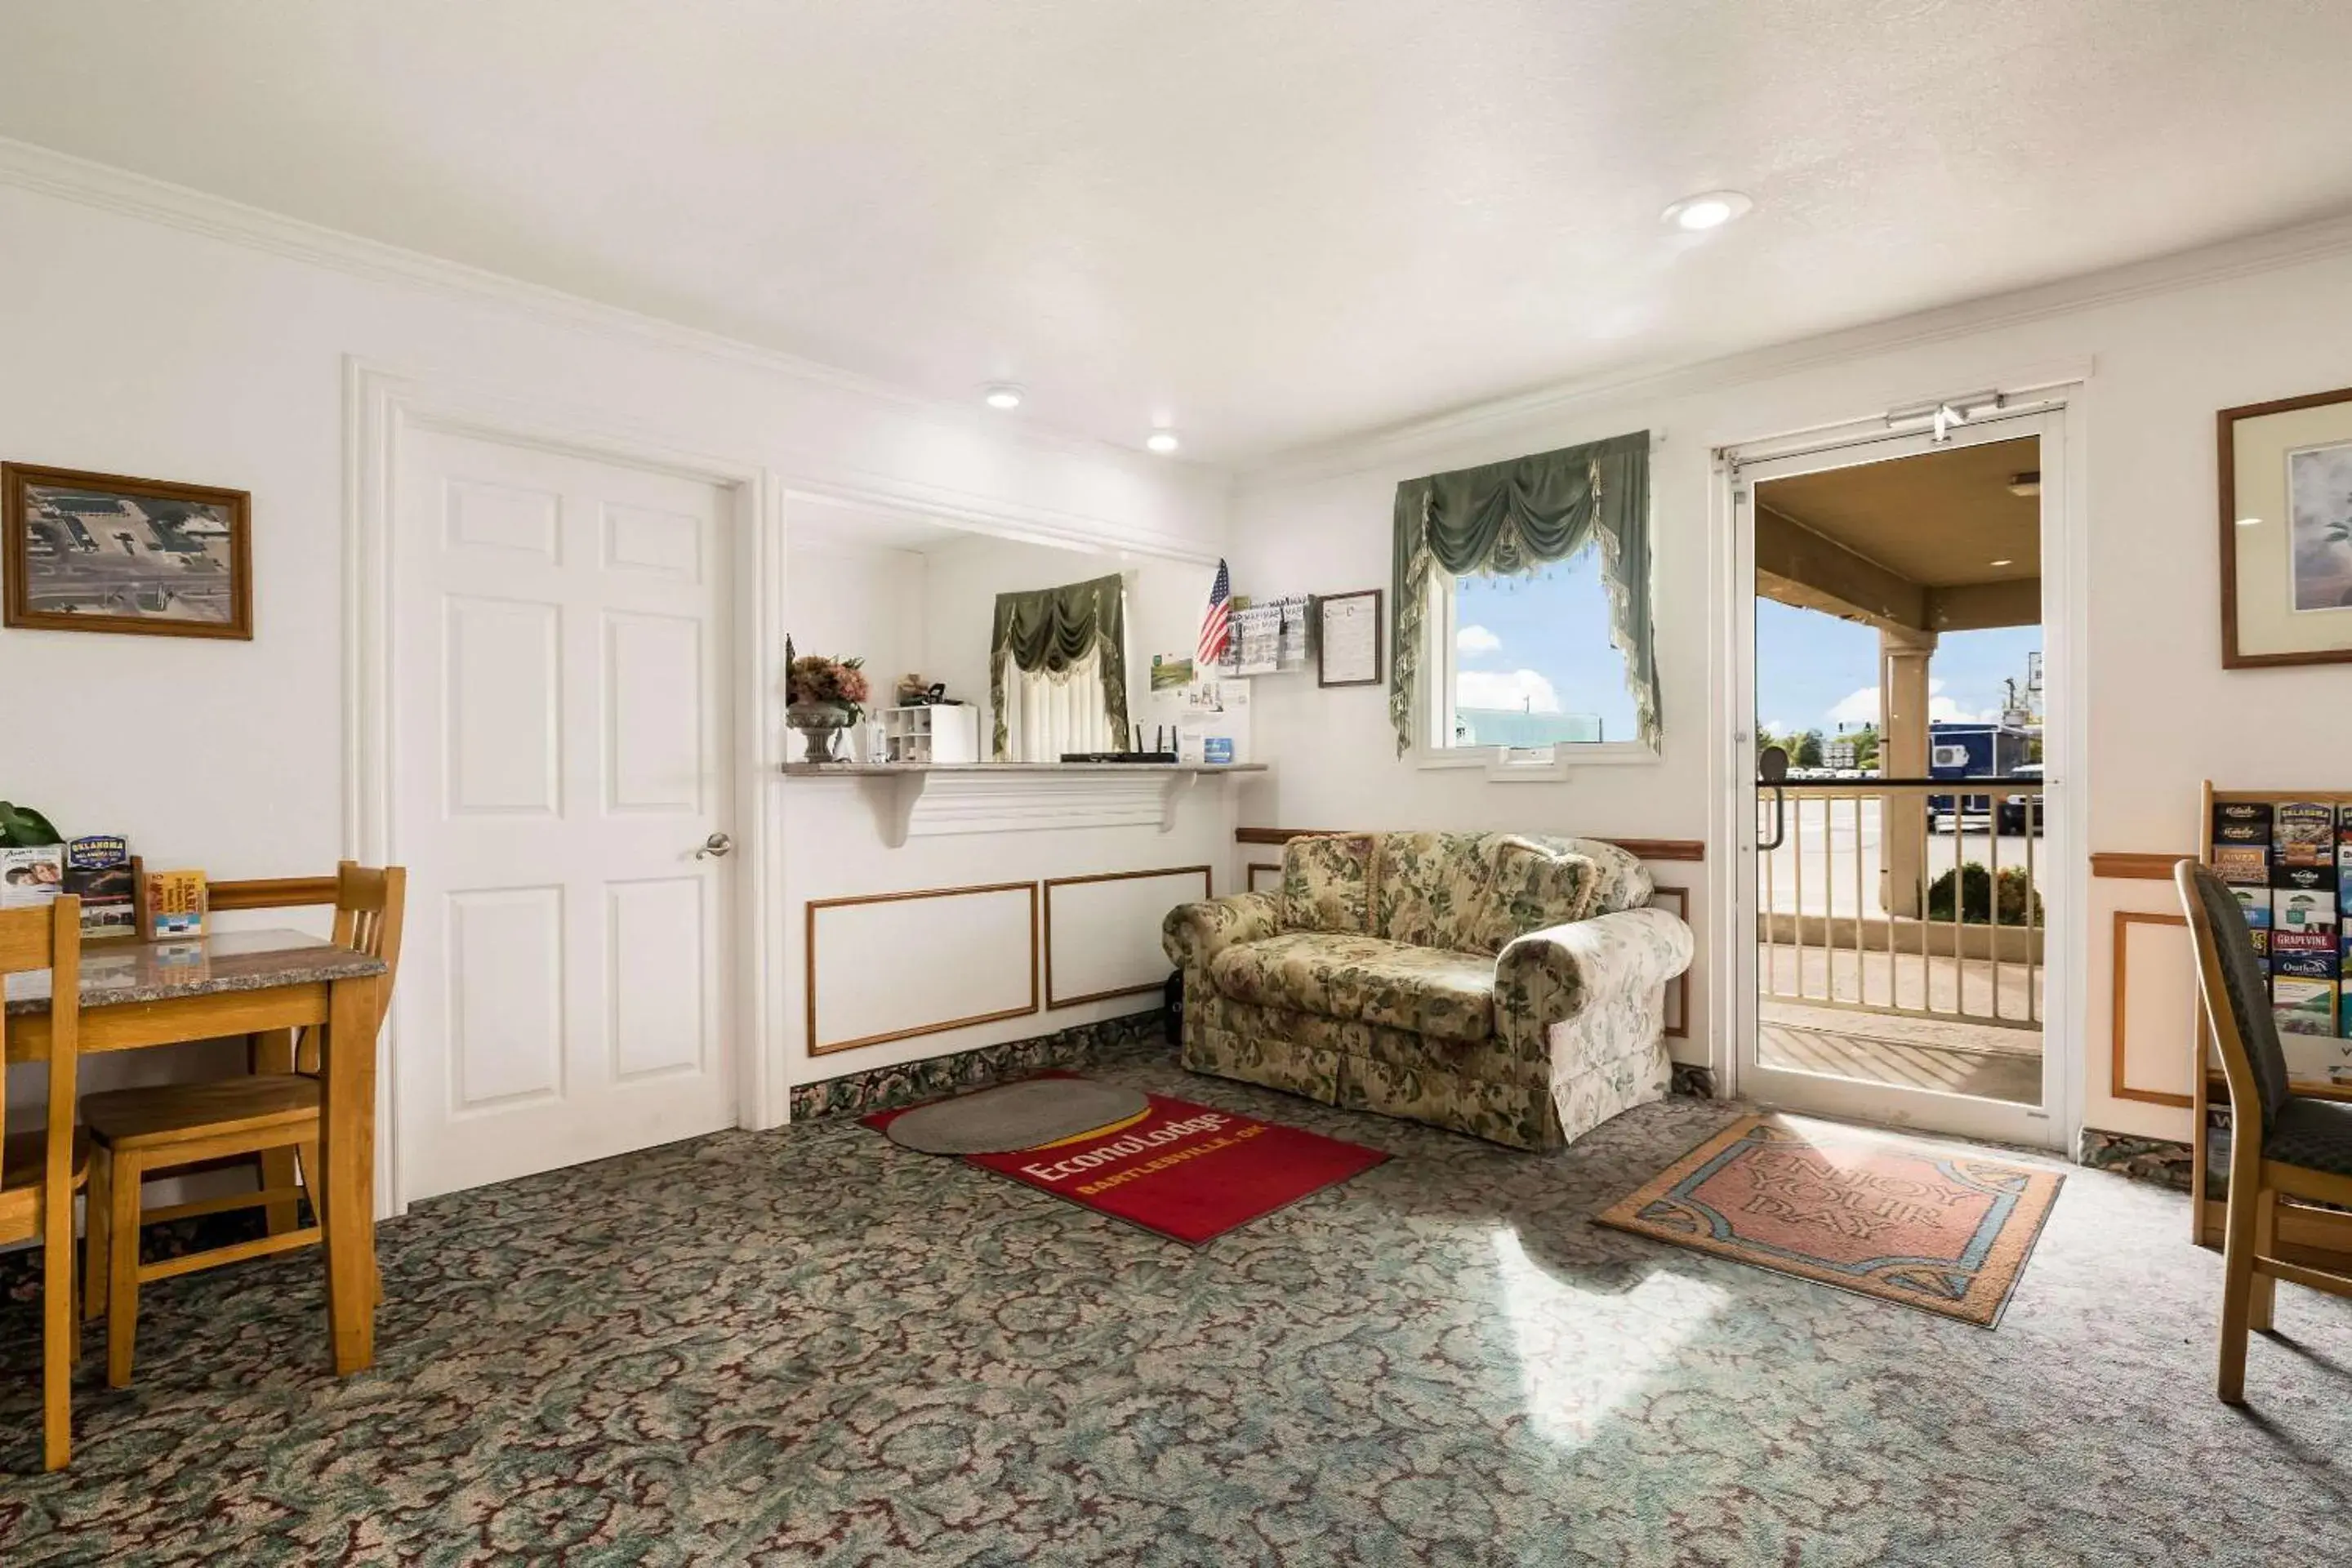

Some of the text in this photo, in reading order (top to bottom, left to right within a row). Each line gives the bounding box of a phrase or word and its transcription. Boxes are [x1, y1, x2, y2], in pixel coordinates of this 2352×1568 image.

[2277, 933, 2328, 947] GRAPEVINE
[1021, 1112, 1231, 1182] EconoLodge
[1740, 1195, 1896, 1240] DAY
[1748, 1168, 1944, 1229] YOUR
